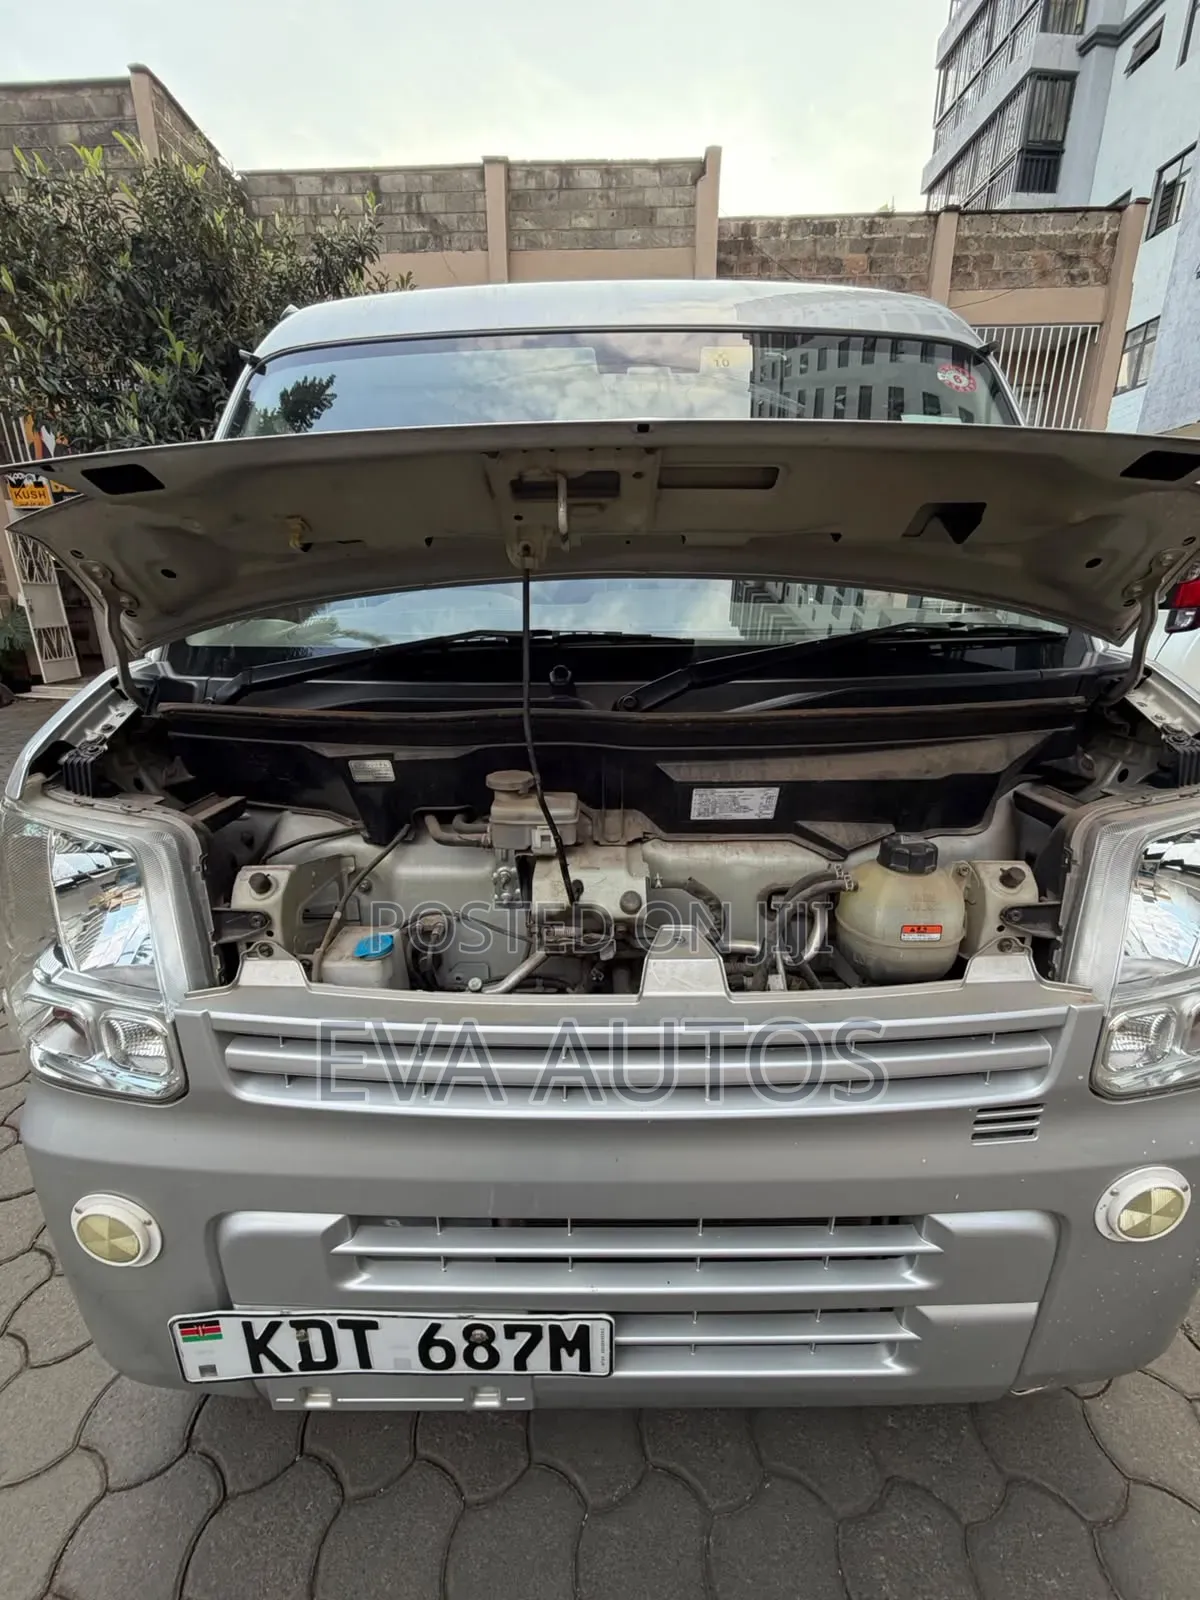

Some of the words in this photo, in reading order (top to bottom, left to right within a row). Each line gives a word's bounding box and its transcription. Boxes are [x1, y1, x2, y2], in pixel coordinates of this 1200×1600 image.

[14, 490, 47, 500] KUSH
[241, 1319, 380, 1374] KDT
[417, 1322, 592, 1373] 687M
